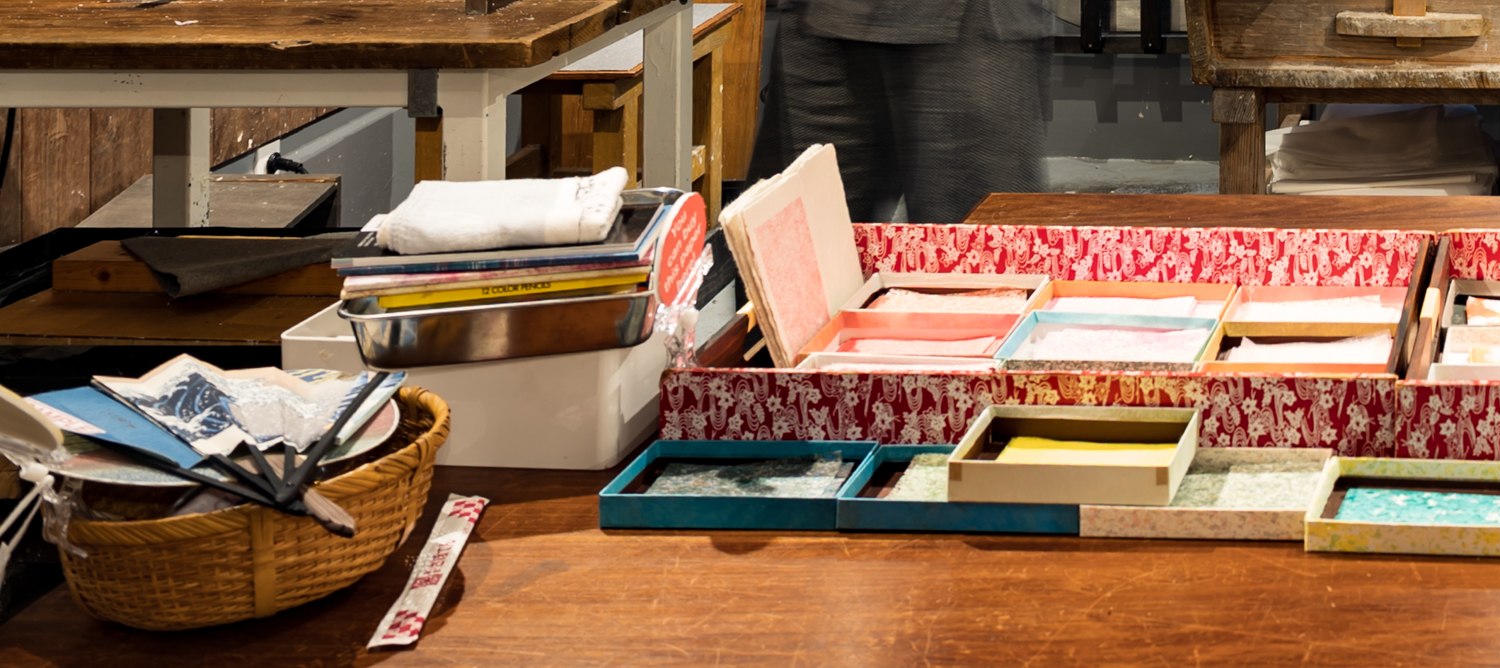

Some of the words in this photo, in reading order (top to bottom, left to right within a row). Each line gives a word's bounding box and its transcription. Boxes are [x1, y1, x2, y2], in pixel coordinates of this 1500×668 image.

[664, 263, 680, 293] this
[680, 221, 702, 268] paper
[667, 239, 682, 268] can
[682, 211, 697, 241] buy
[481, 286, 490, 295] 12
[491, 284, 519, 294] COLOR
[521, 281, 552, 291] PENCILS
